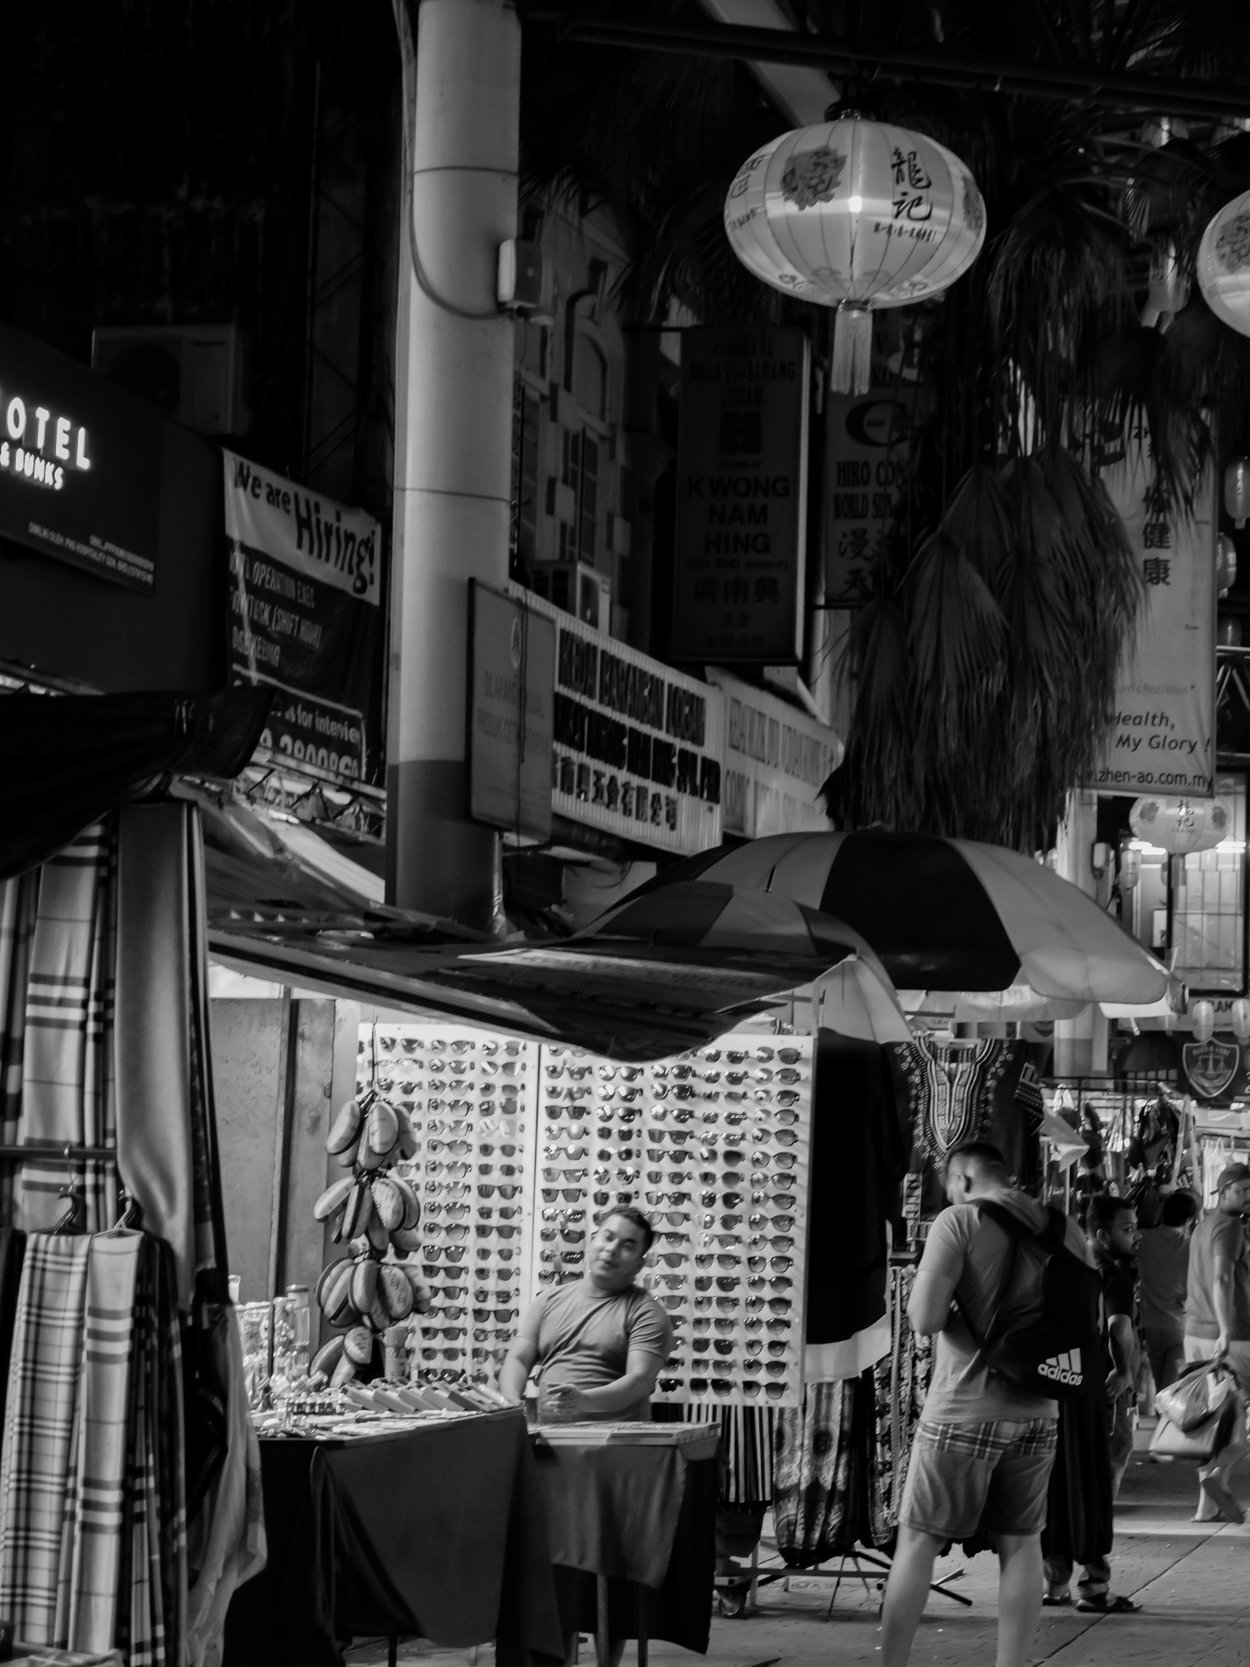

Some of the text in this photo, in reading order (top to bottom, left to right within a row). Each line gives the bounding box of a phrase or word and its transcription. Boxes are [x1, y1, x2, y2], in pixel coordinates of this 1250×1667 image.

[3, 392, 93, 472] OTEL
[15, 447, 64, 491] BUNKS
[836, 460, 871, 486] HIRO
[688, 476, 790, 498] KWONG
[707, 503, 768, 525] NAM
[234, 458, 262, 499] We
[266, 483, 291, 514] are
[294, 492, 375, 594] Hiring!
[704, 532, 770, 555] HING
[1115, 734, 1142, 753] My
[1148, 734, 1199, 755] Glory
[1085, 768, 1212, 792] .zhen-ao.com.my
[1037, 1363, 1083, 1386] adidas
